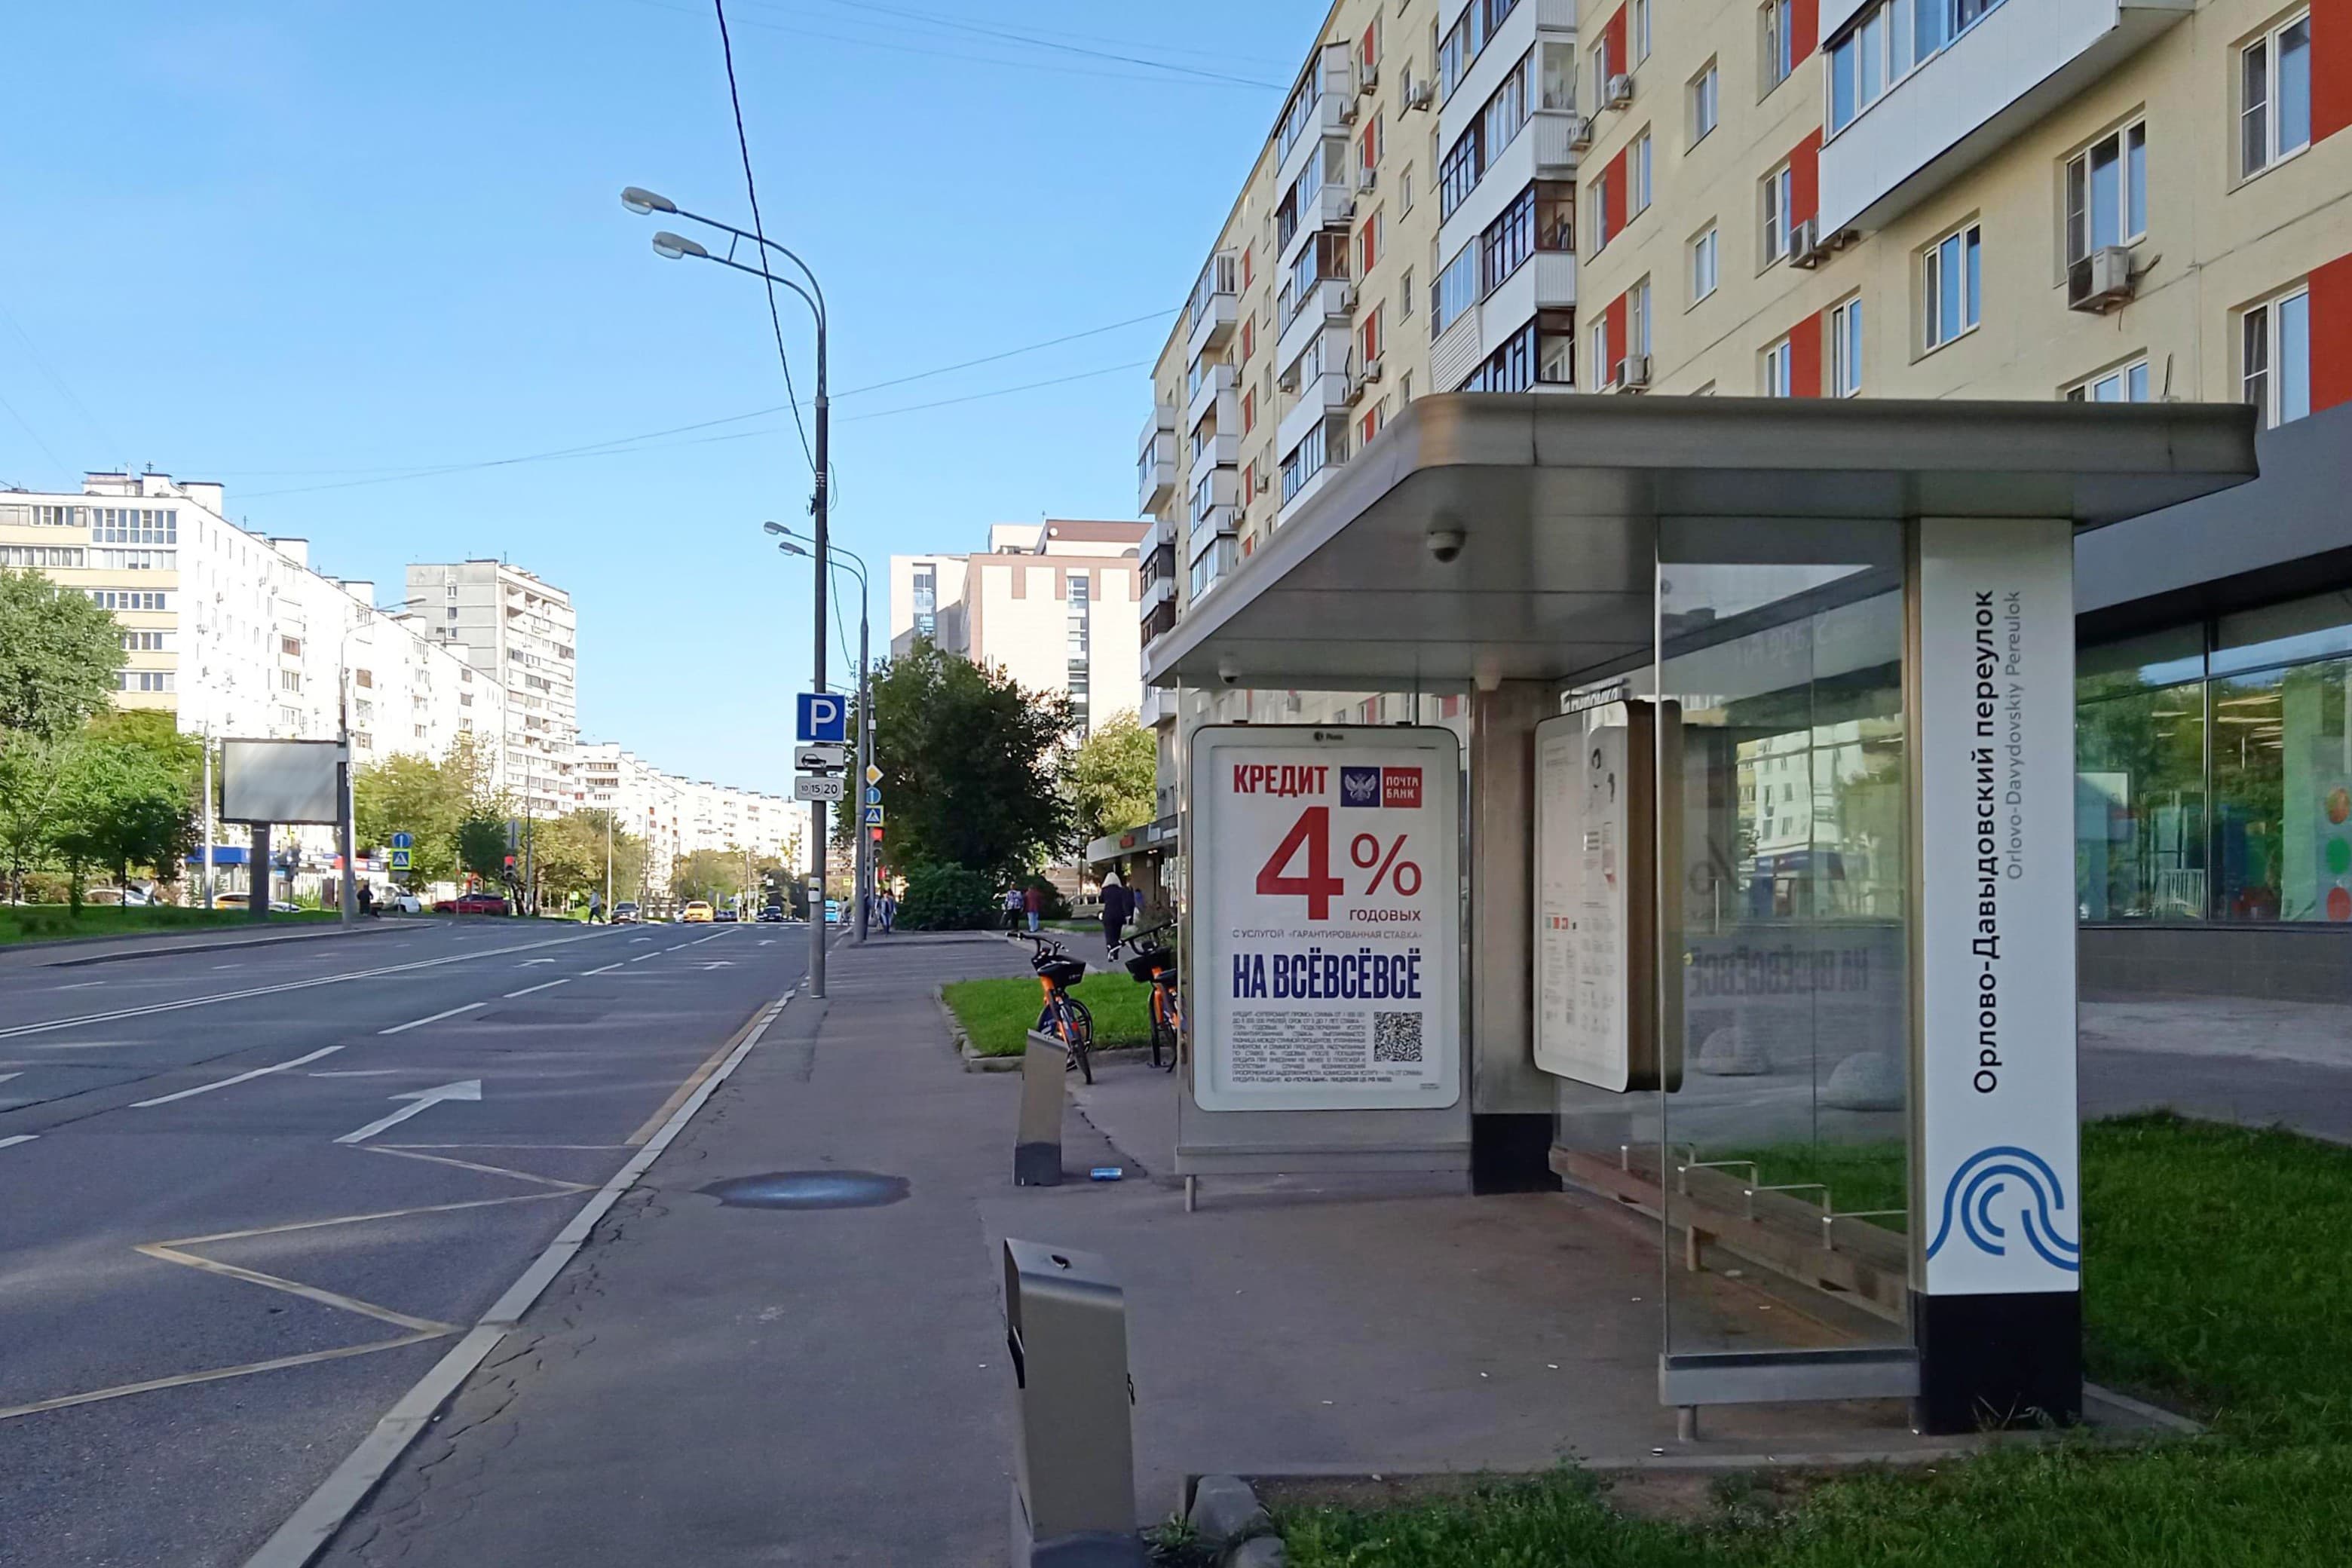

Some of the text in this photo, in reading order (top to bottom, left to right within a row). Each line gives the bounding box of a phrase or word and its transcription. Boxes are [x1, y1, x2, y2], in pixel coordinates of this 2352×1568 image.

[810, 698, 838, 737] P
[2003, 591, 2025, 880] Orlovo-Davydovskiy Pereulok
[811, 784, 821, 793] 15
[823, 783, 838, 795] 20
[1233, 764, 1329, 798] КРЕДИТ
[1386, 776, 1419, 787] ПОЧТА
[1386, 789, 1415, 799] БАНК
[1971, 590, 2002, 1094] Орлово-Давыдовский переулок
[1349, 909, 1422, 923] ГОДОВЫХ
[1232, 929, 1240, 939] С
[1242, 928, 1285, 939] УСЛУГОЙ
[1233, 947, 1422, 1000] НА ВСЁВСЁВСЁ
